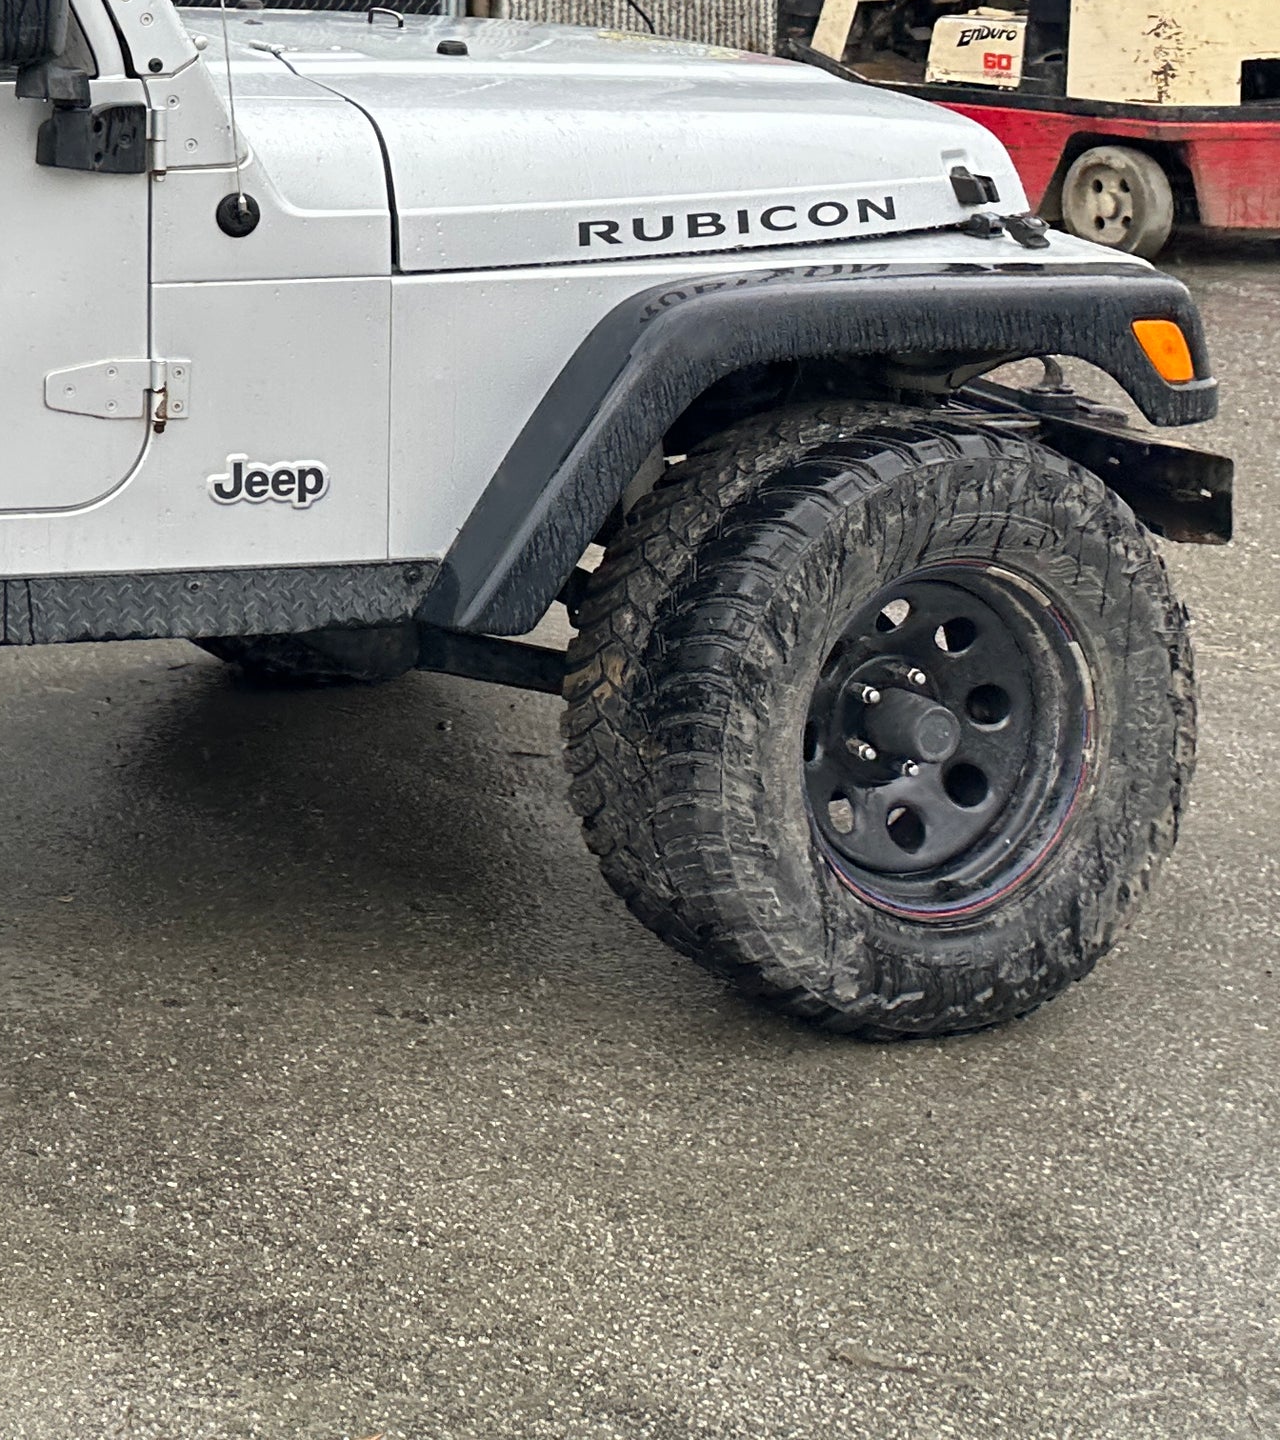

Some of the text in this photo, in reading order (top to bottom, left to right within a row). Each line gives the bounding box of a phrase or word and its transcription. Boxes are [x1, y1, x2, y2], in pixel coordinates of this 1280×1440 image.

[983, 52, 1012, 71] 60
[578, 196, 897, 247] RUBICON
[213, 461, 324, 503] Jeep
